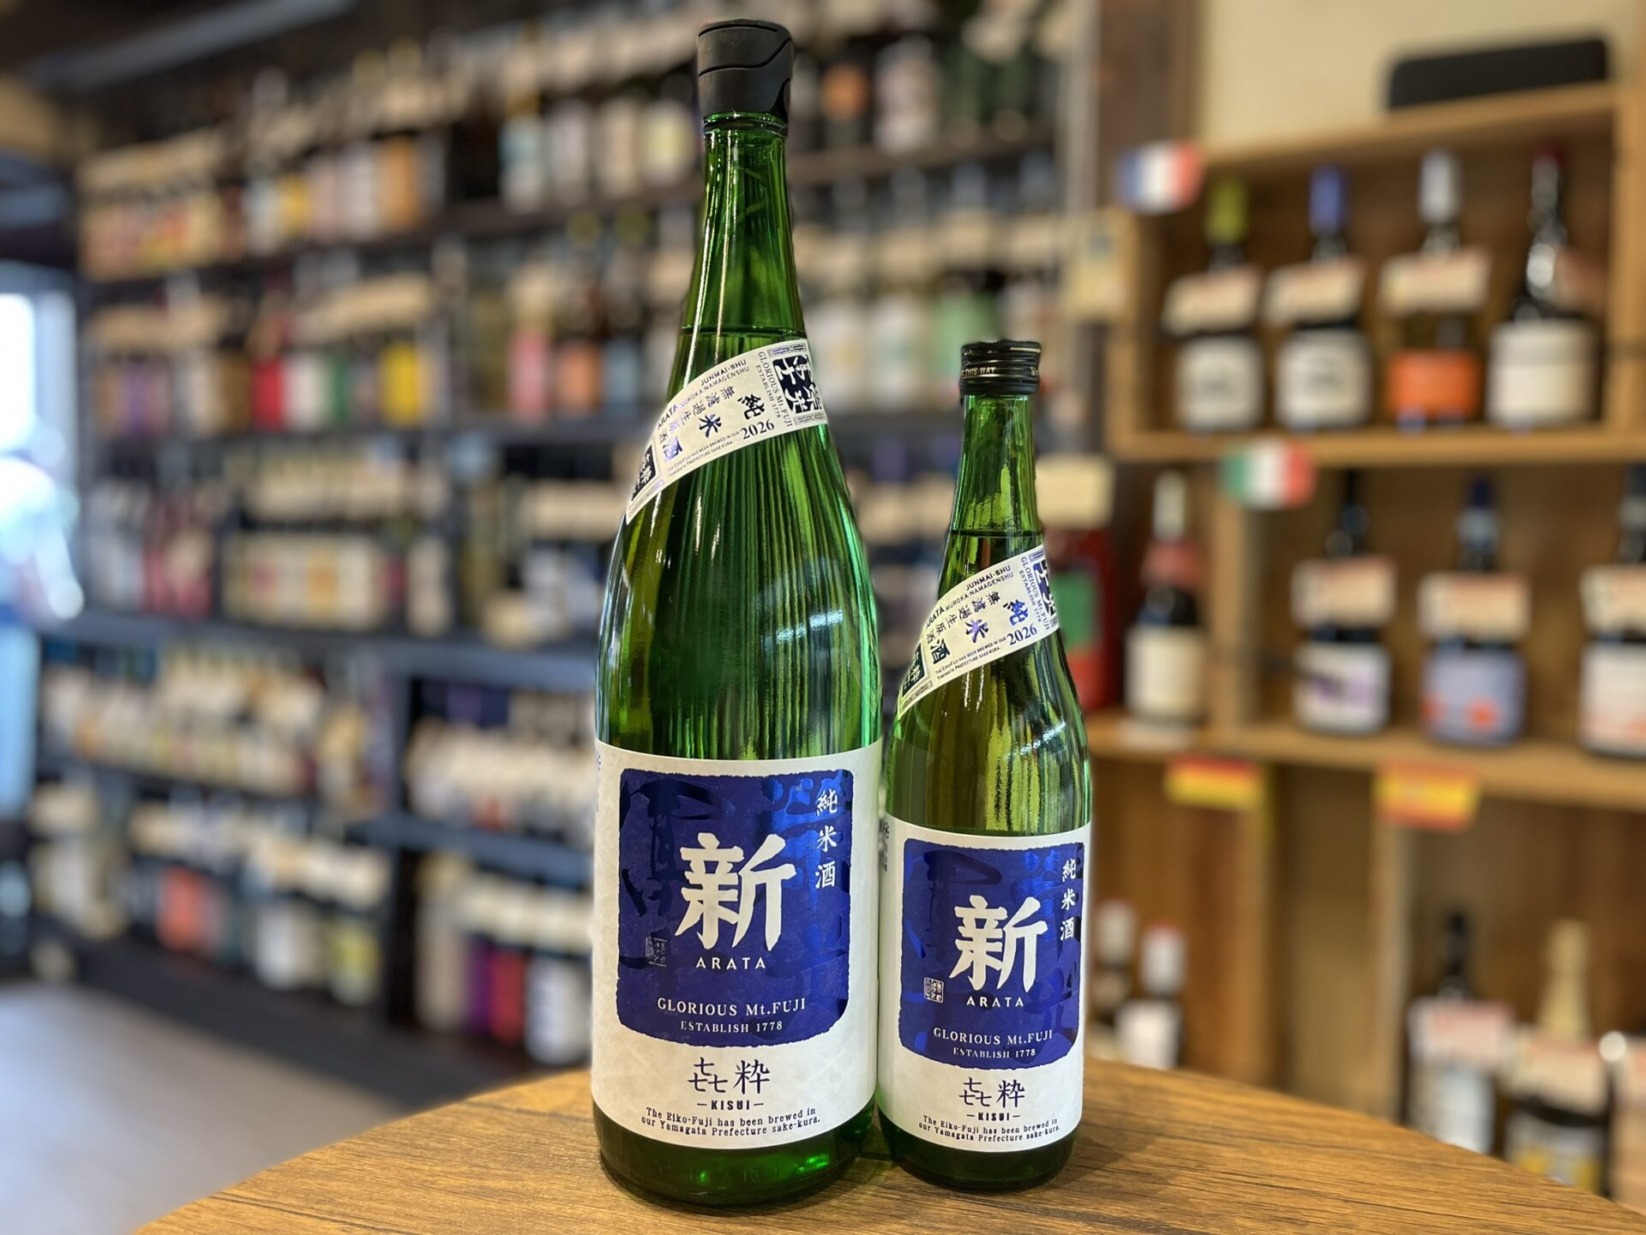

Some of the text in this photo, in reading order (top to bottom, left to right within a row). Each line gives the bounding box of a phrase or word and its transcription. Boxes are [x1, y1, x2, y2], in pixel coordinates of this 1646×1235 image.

[700, 359, 747, 387] JUNMAI-SHU
[756, 364, 775, 402] ESTABLISH
[758, 351, 778, 394] GLORIOUS
[741, 421, 775, 440] 2026
[966, 565, 1011, 591] JUNMAI-SHU
[1019, 569, 1036, 606] ESTABLISH
[1020, 556, 1039, 598] GLORIOUS
[1007, 623, 1038, 646] 2026
[815, 789, 838, 888] 純米酒
[674, 832, 797, 951] 新
[1060, 858, 1077, 941] 純米酒
[949, 894, 1048, 993] 新
[696, 956, 766, 970] ARATA
[657, 997, 806, 1016] GLORIOUS Mt.FUJI
[966, 995, 1024, 1008] ARATA
[680, 1020, 783, 1033] ESTABLISH 1778
[933, 1027, 1053, 1045] GLORIOUS Mt.FUJI
[953, 1047, 1036, 1059] ESTABLISH 1778
[710, 1100, 751, 1111] KISUI
[641, 1115, 821, 1137] our Yamagata Prefecture sake-kura.
[646, 1107, 816, 1128] The Eiko-Fuji has been brewed in
[923, 1114, 937, 1126] The
[940, 1120, 979, 1134] Eiko-Fuji
[982, 1126, 998, 1134] has
[1001, 1126, 1020, 1134] been
[1023, 1120, 1050, 1132] brewed
[977, 1112, 1010, 1121] KISUI
[918, 1122, 931, 1132] our
[934, 1126, 974, 1140] Yamagata
[978, 1134, 1023, 1142] Prefecture
